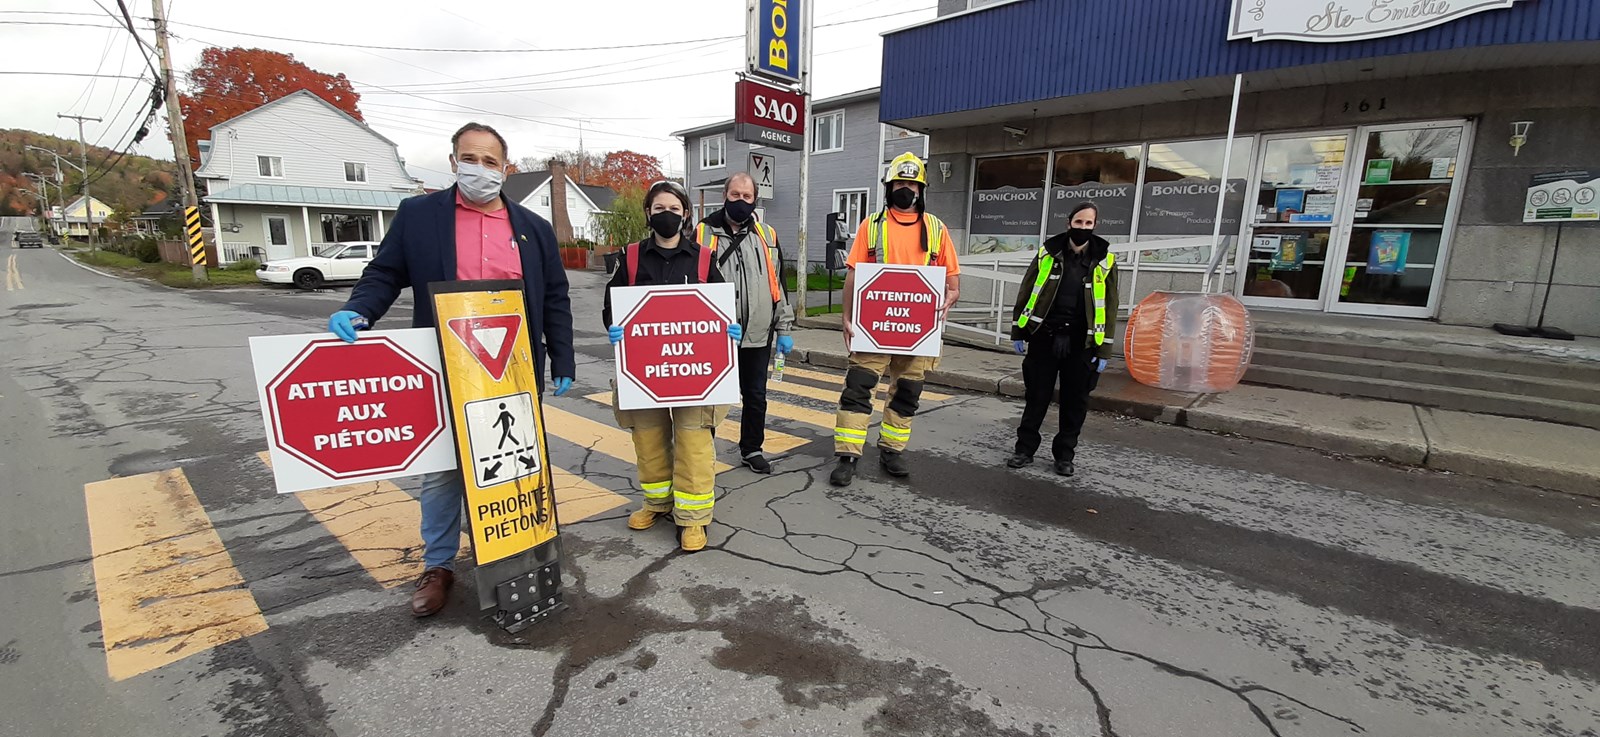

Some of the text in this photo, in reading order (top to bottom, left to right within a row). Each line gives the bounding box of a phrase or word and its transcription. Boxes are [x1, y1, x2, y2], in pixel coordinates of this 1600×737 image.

[769, 0, 788, 71] BO
[754, 94, 798, 126] SAQ
[761, 130, 791, 143] AGENCE
[978, 191, 1038, 202] BONICHOIX
[1056, 187, 1128, 200] BONICHOIX
[1151, 182, 1237, 196] BONICHOX
[865, 290, 932, 303] ATTENTION
[885, 307, 910, 317] AUX
[631, 320, 721, 337] ATTENTION
[872, 320, 921, 333] PIÉTONS
[661, 342, 694, 356] AUX
[645, 362, 712, 378] PIÉTONS
[288, 374, 424, 400] ATTENTION
[337, 403, 387, 422] AUX
[314, 425, 415, 451] PIÉTONS
[478, 484, 547, 521] PRIORITÉ
[484, 508, 549, 543] PIÉTONS
